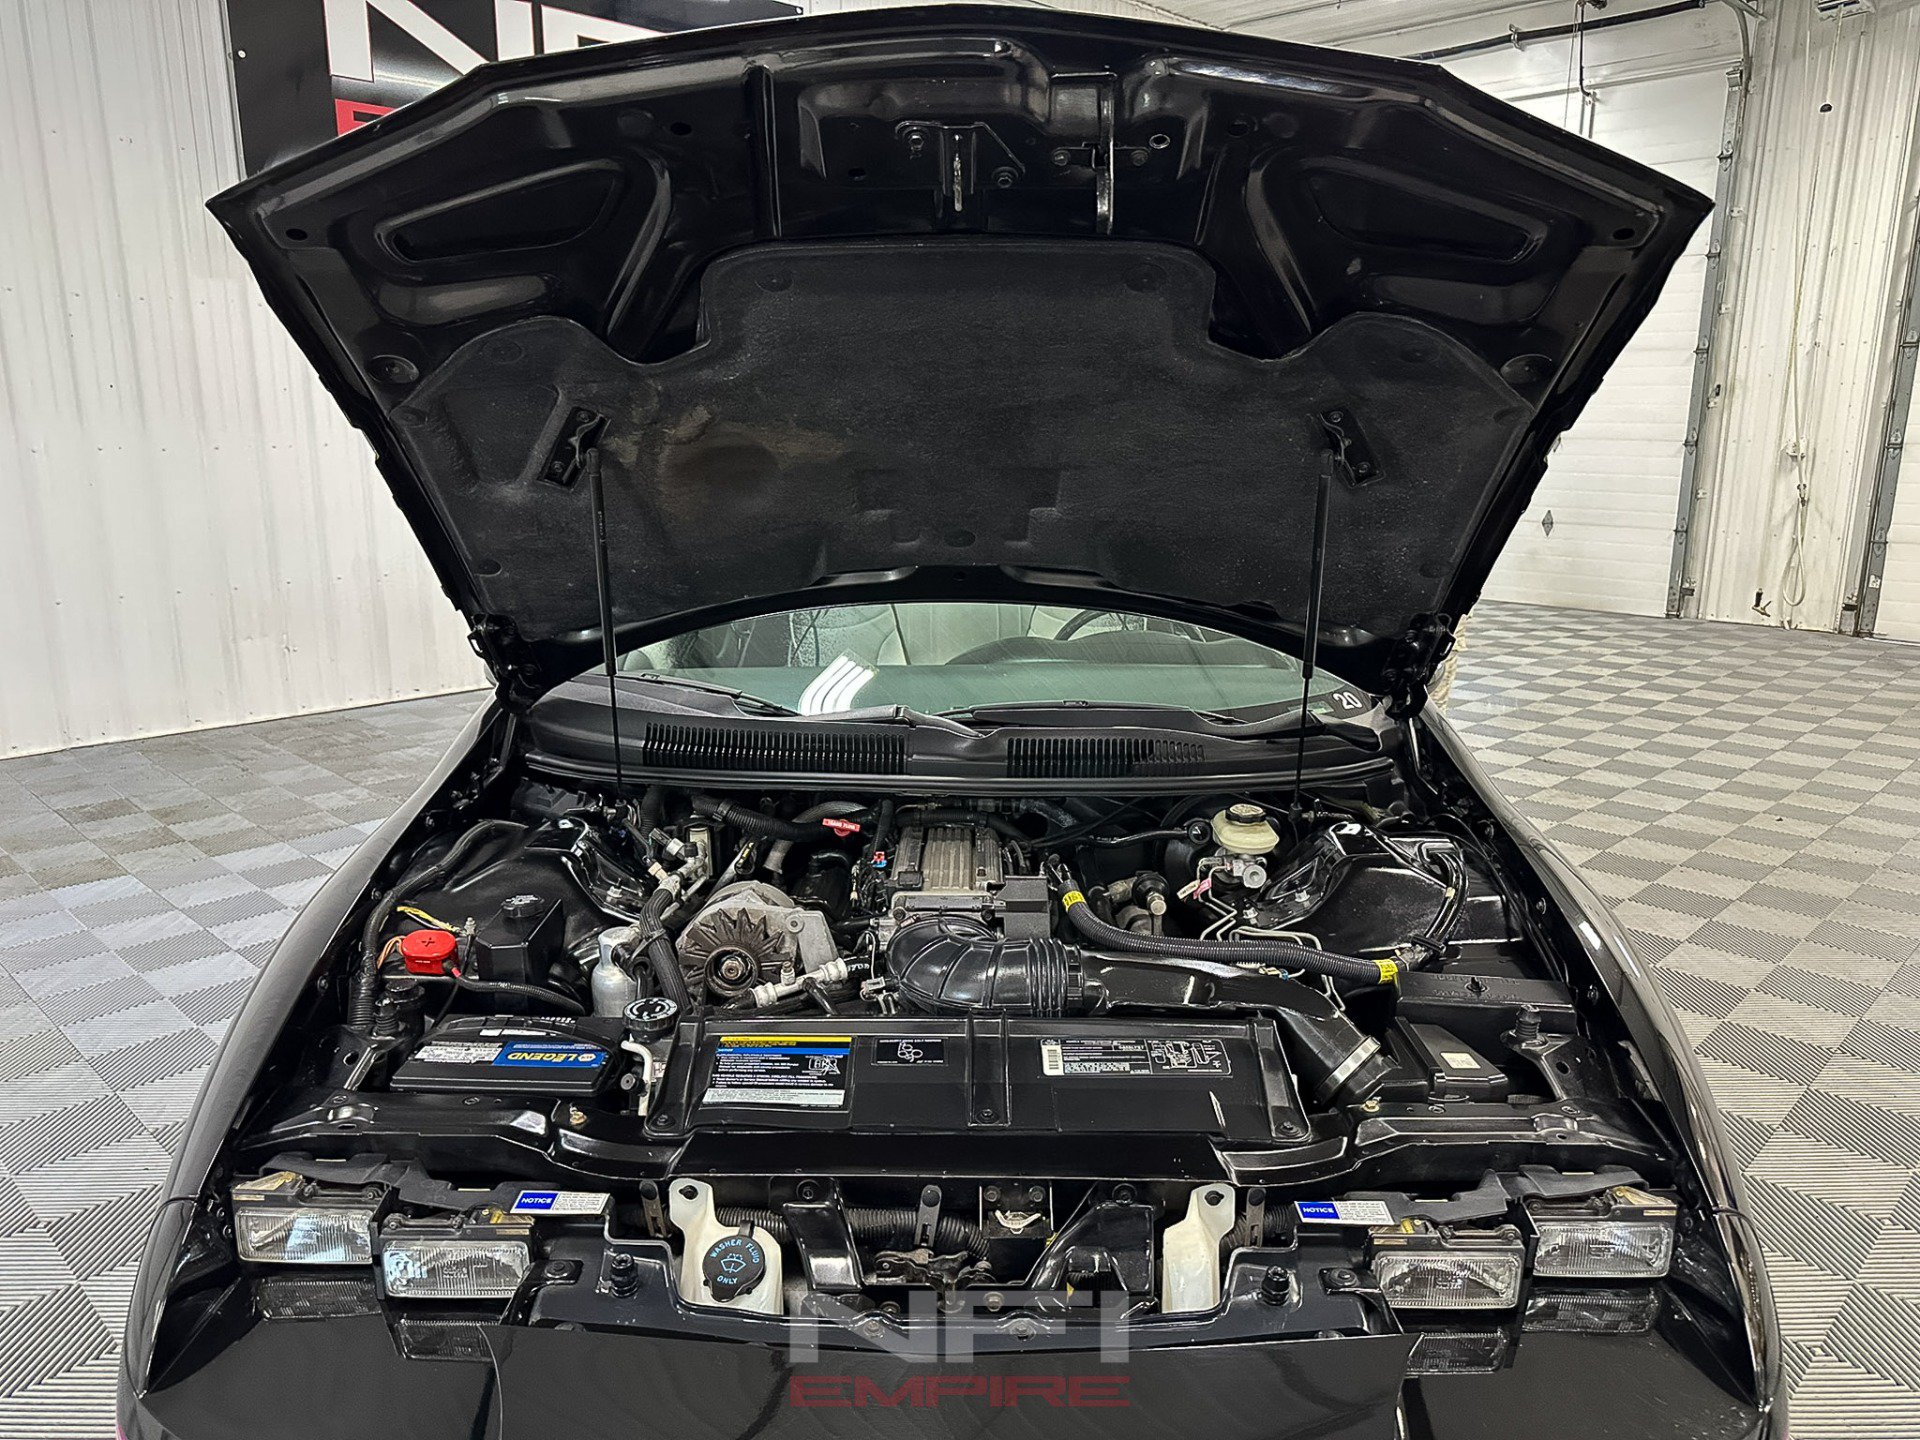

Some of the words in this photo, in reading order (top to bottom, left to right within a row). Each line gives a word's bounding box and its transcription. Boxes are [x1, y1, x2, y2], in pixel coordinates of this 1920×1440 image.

[1333, 691, 1363, 710] 20
[507, 1052, 578, 1062] LEGEND
[710, 1239, 743, 1258] WASHER
[745, 1243, 760, 1264] FLUID
[716, 1275, 738, 1285] ONLY
